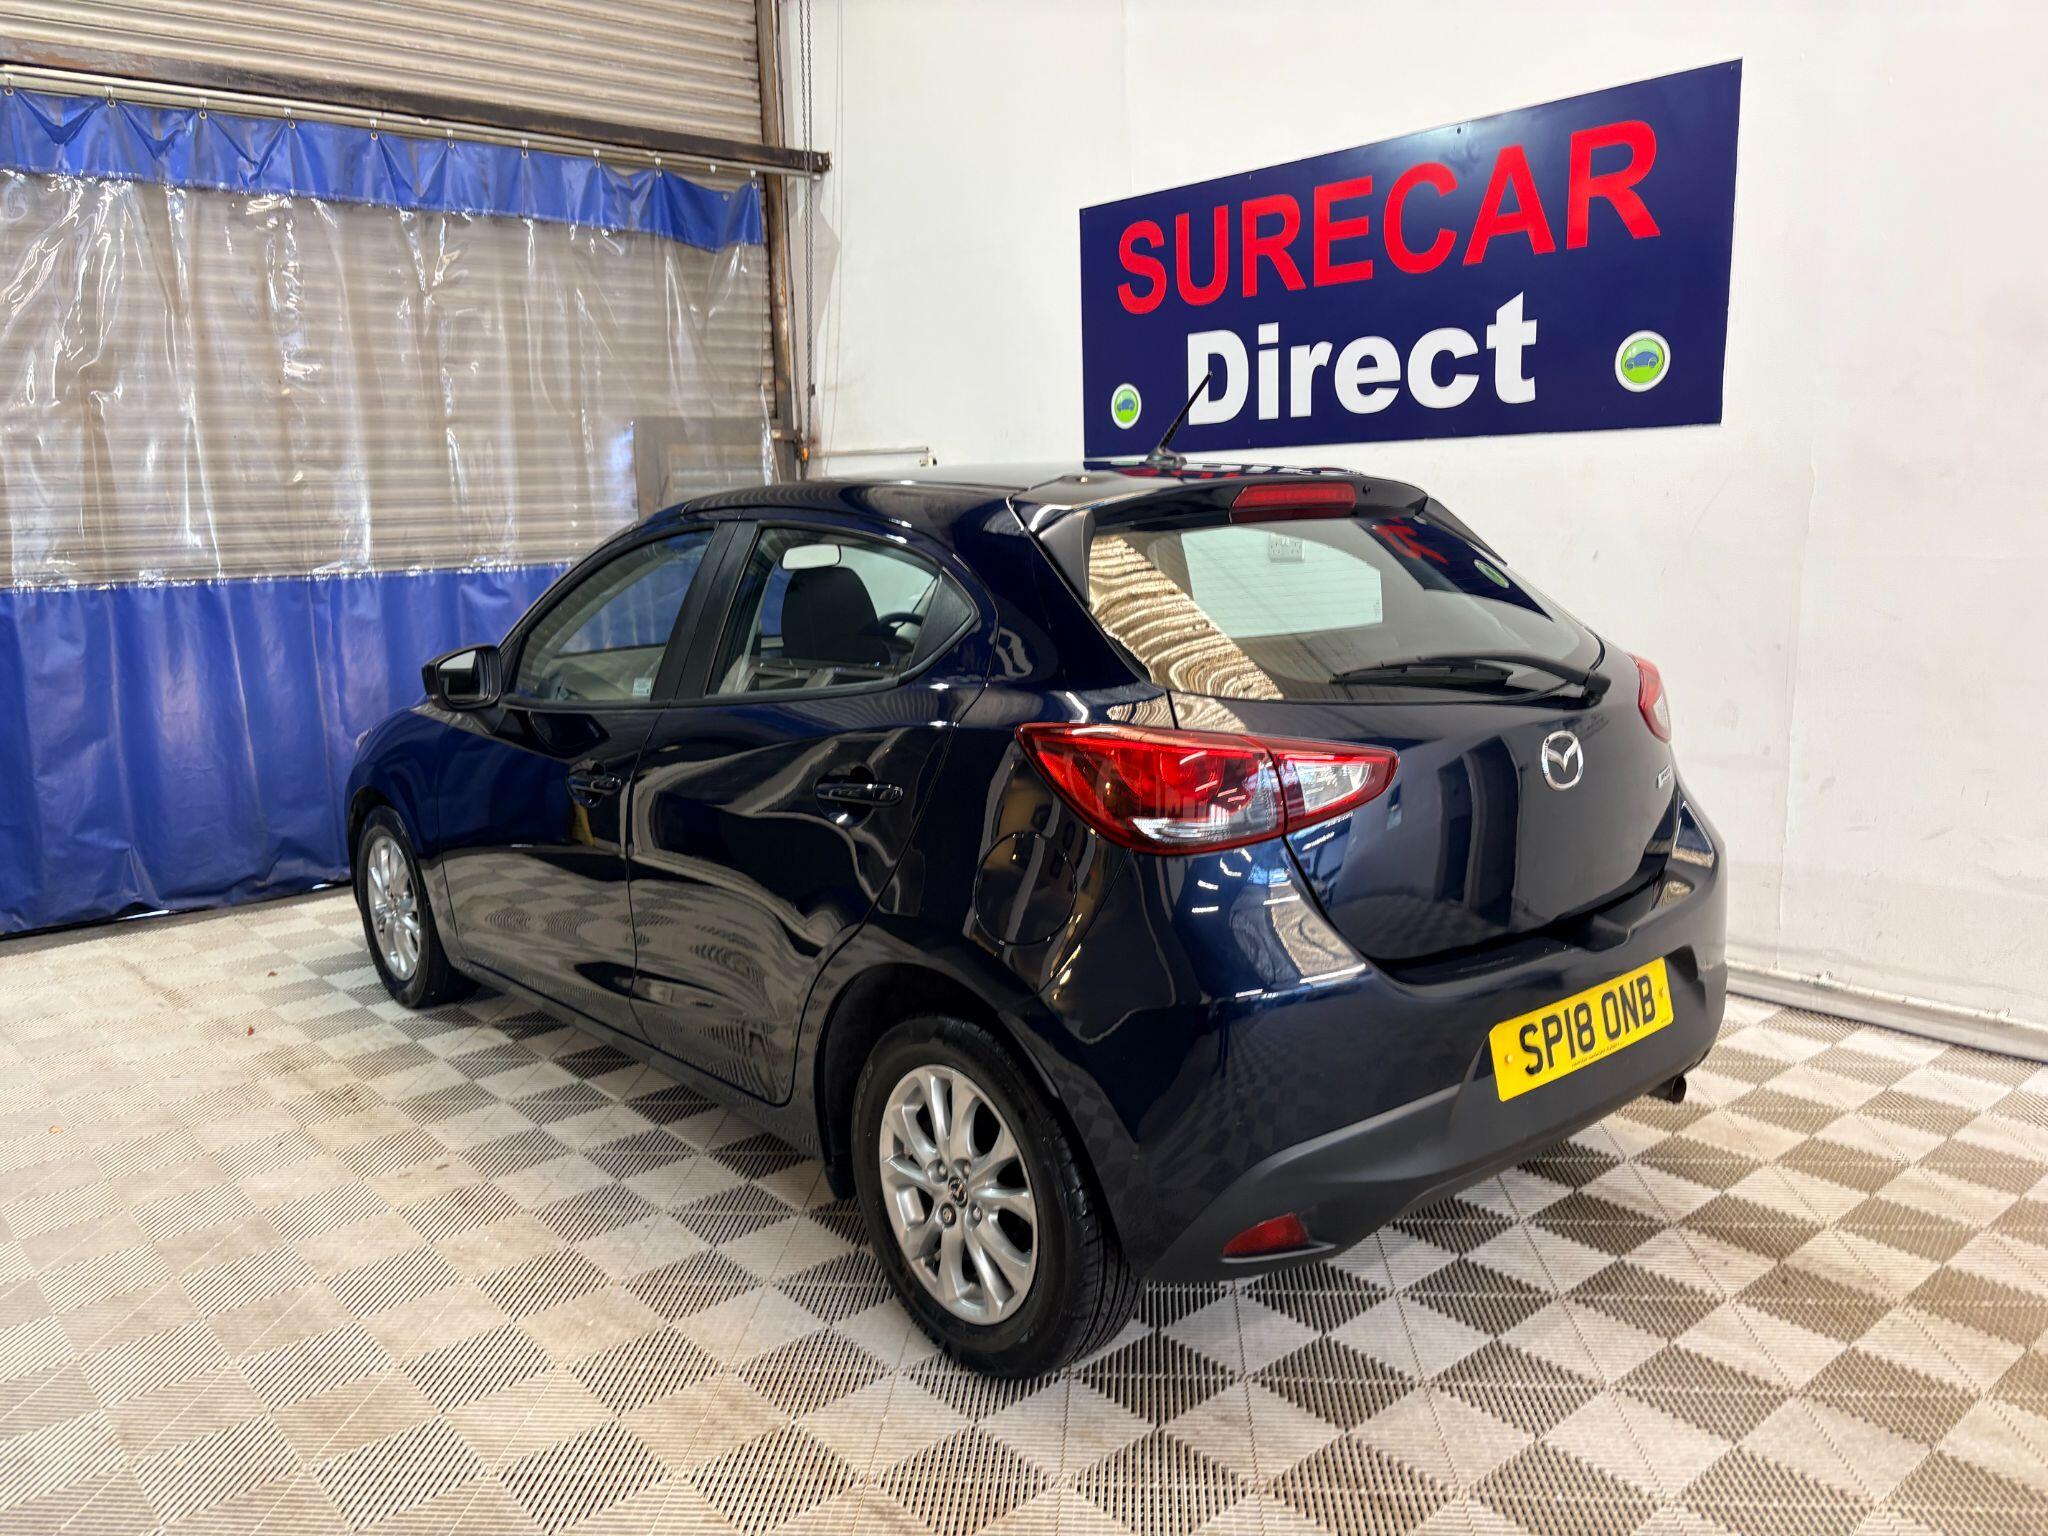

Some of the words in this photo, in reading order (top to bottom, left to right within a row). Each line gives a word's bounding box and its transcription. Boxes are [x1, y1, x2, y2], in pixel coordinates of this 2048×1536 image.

[1117, 120, 1661, 315] SURECAR
[1187, 292, 1537, 426] Direct
[1519, 1002, 1596, 1076] SP18
[1601, 975, 1656, 1040] ONB
